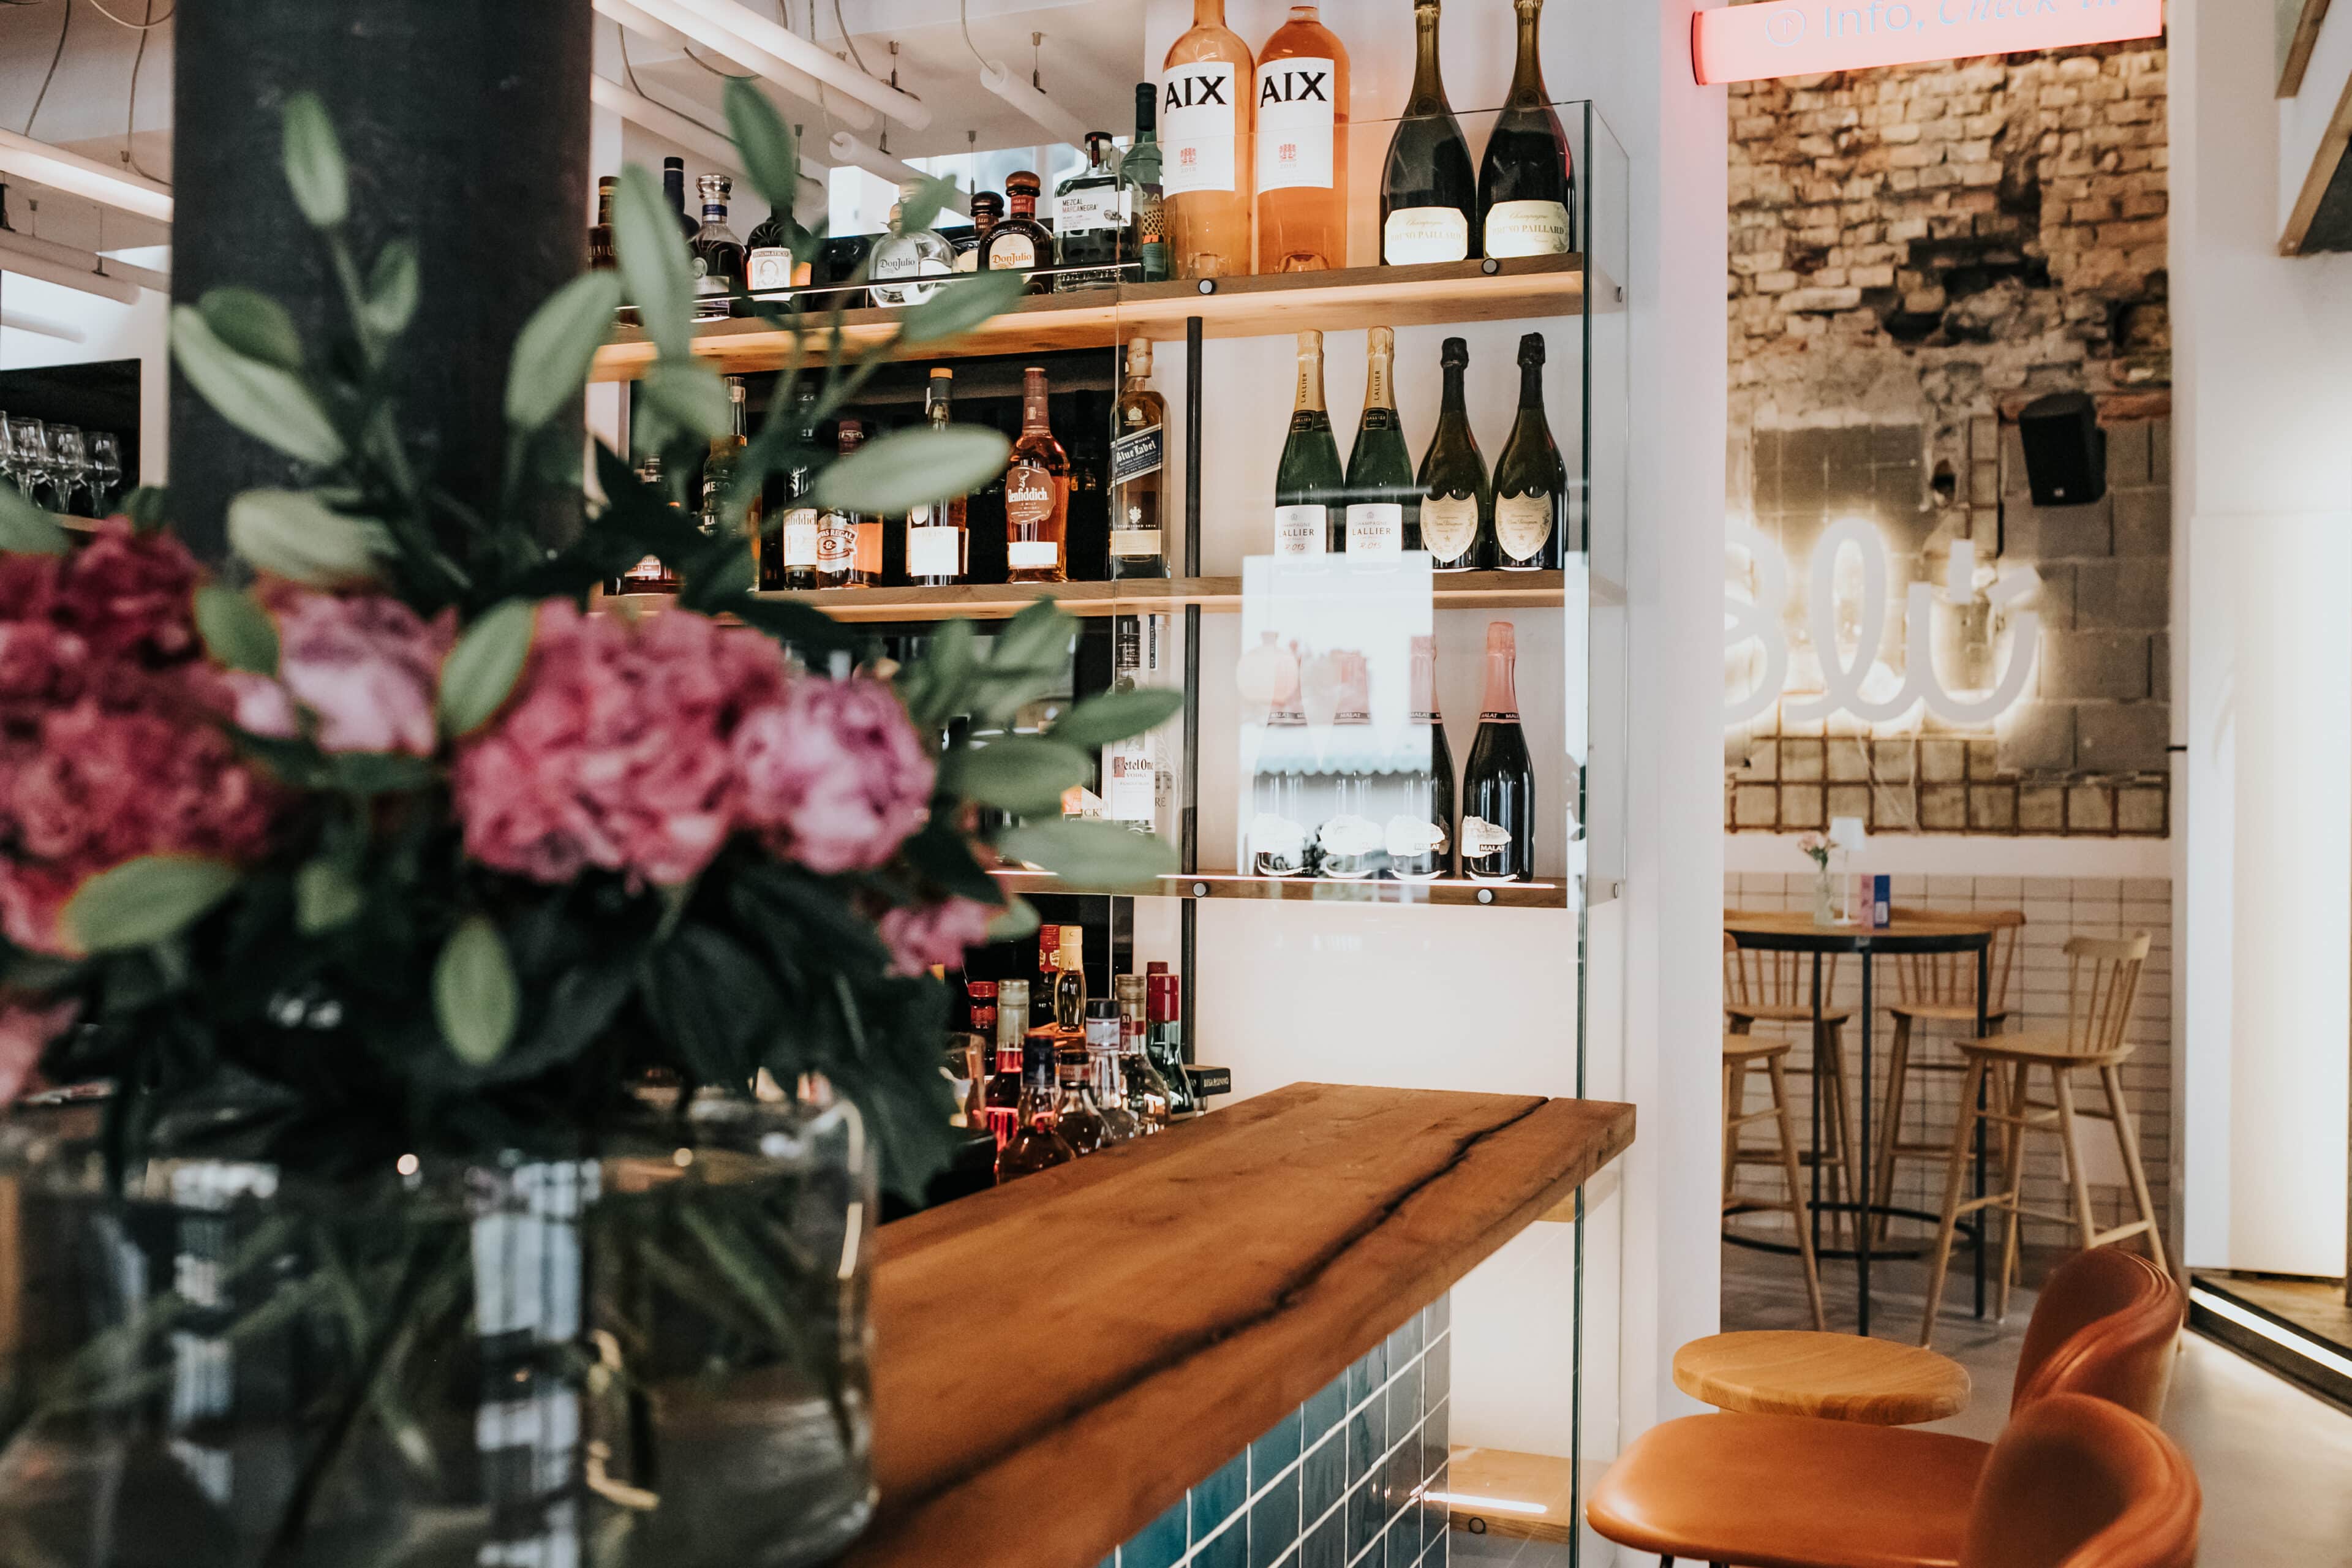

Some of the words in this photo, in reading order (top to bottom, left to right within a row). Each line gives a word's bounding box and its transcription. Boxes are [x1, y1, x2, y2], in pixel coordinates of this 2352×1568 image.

[1825, 0, 1924, 38] Info,
[1164, 75, 1228, 115] AIX
[1260, 71, 1328, 108] AIX
[1521, 224, 1565, 235] PAILLARD
[1133, 439, 1156, 457] Label
[1278, 529, 1314, 538] LALLIER
[1352, 527, 1392, 535] LALLIER
